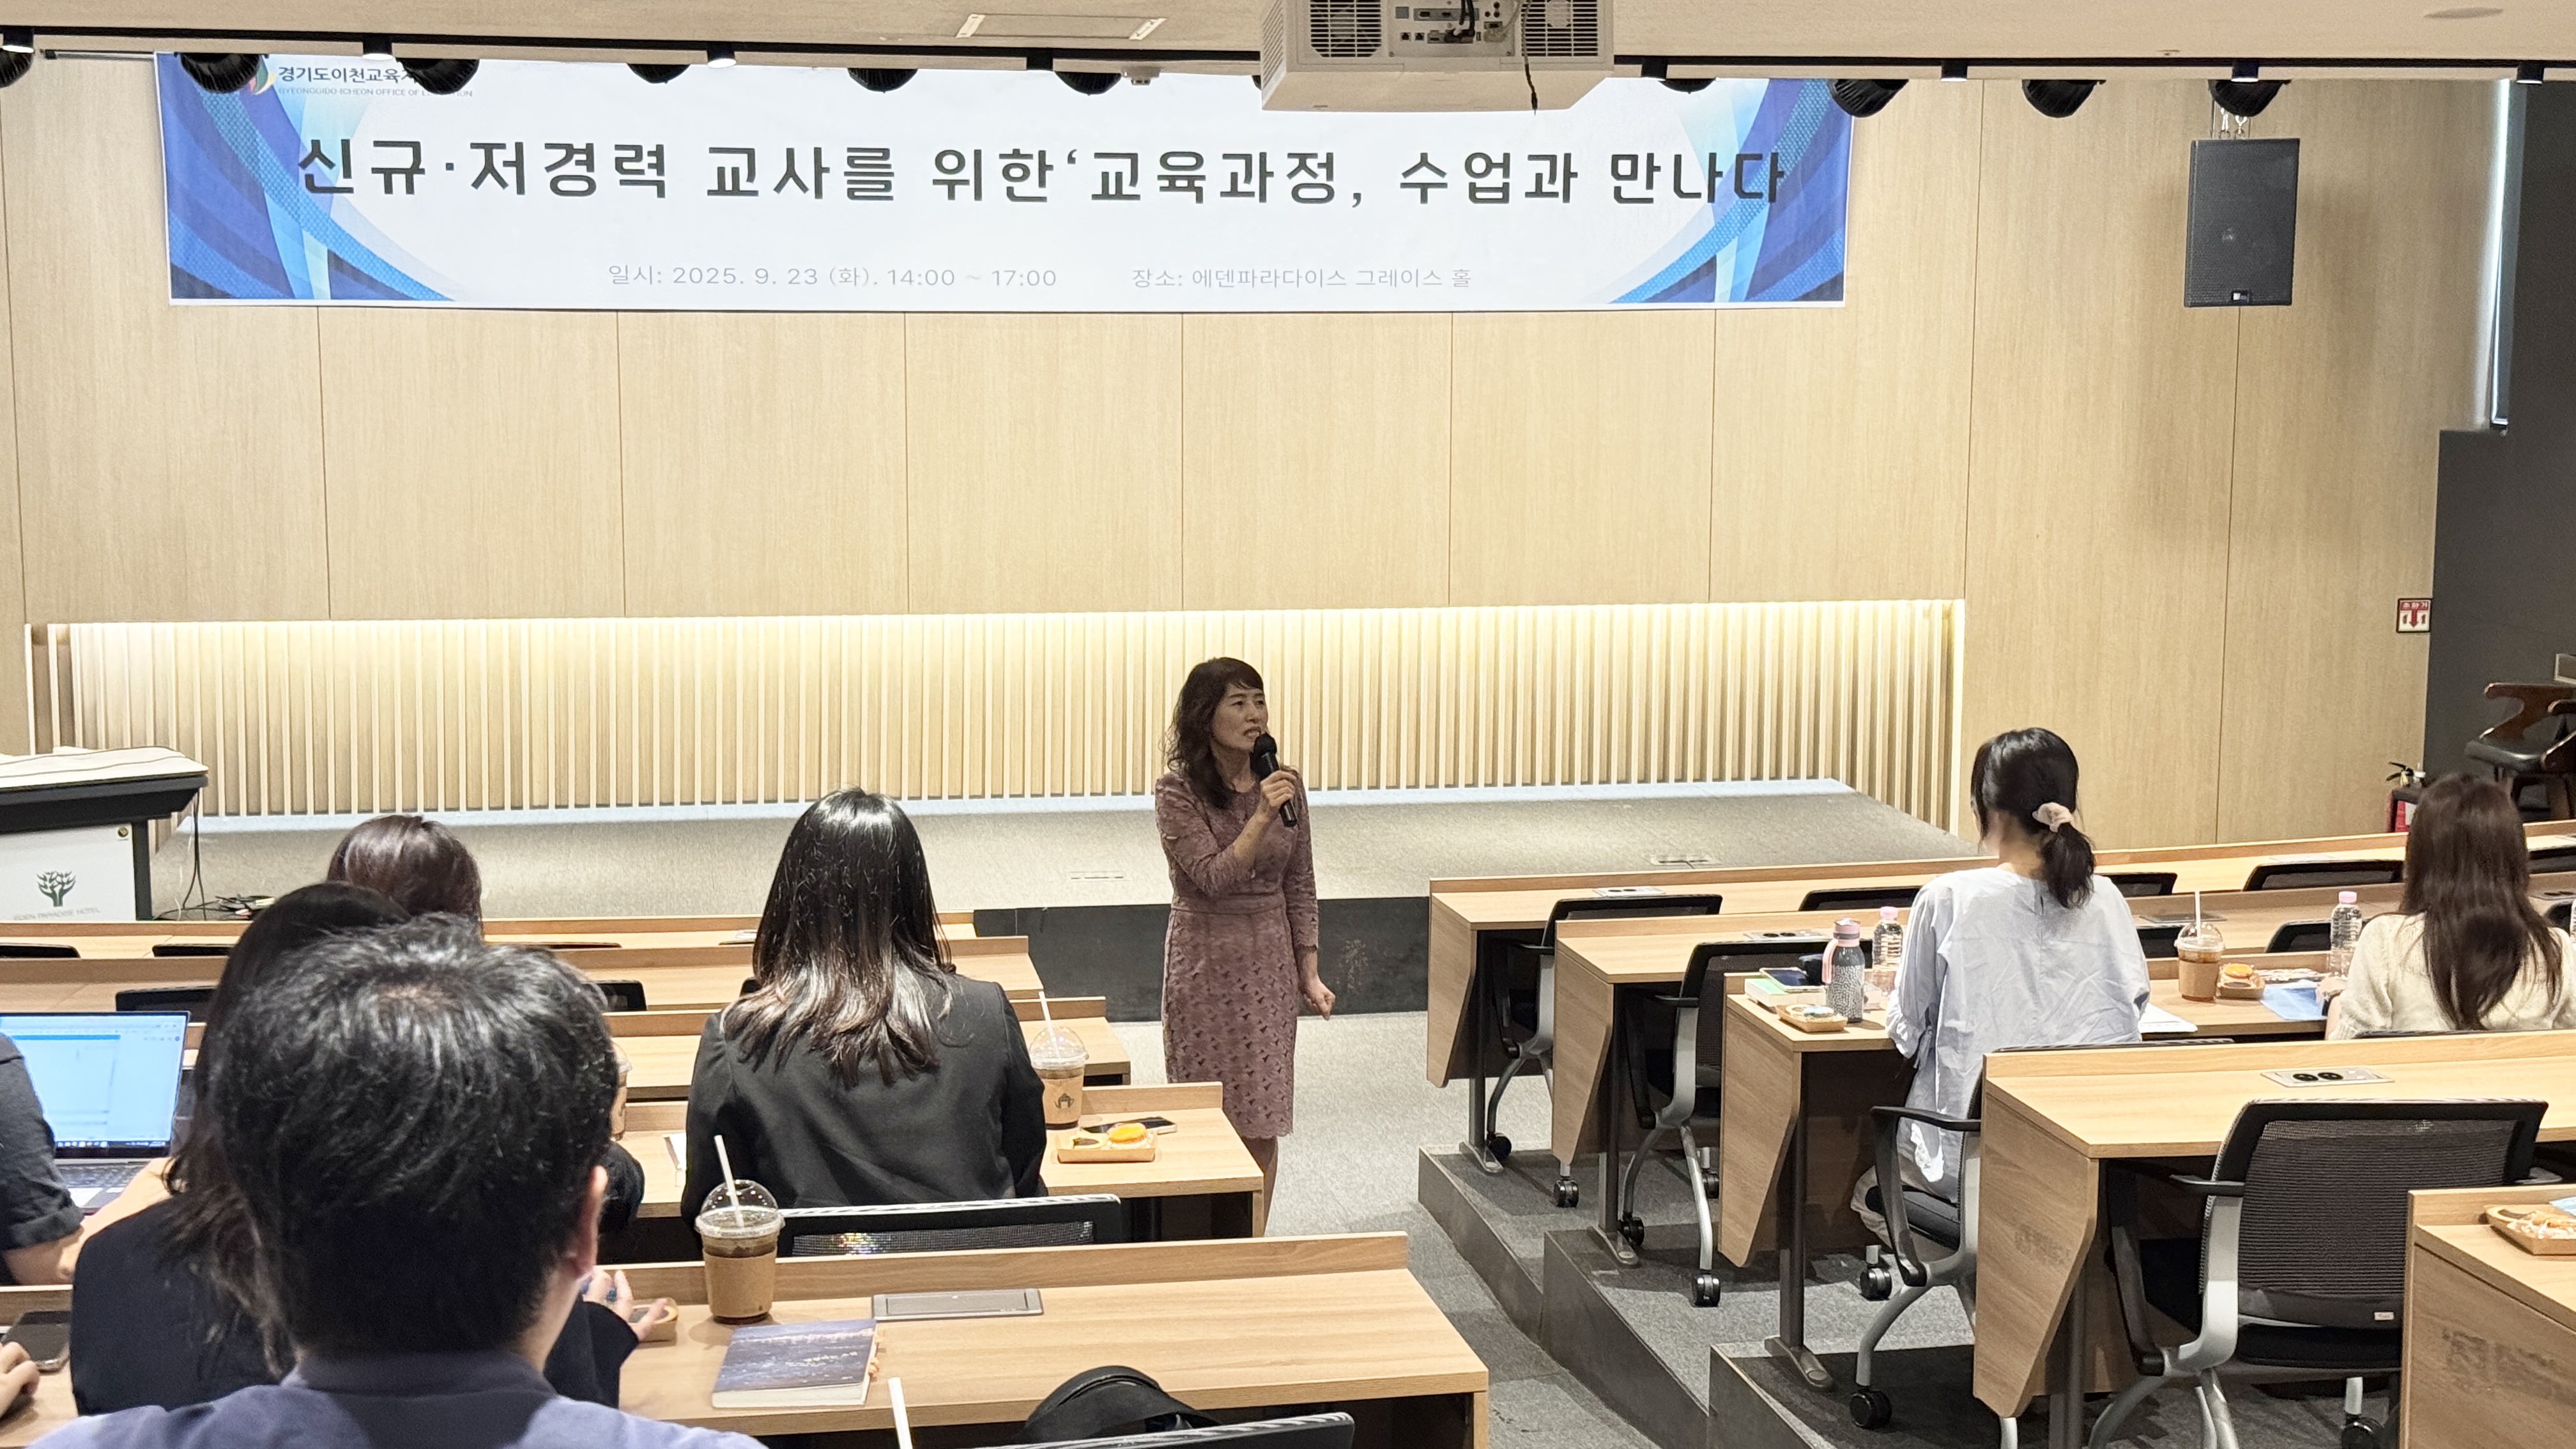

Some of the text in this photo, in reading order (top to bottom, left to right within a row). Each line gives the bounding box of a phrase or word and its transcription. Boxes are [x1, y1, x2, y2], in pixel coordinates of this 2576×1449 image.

[297, 138, 666, 199] 신규·저경력
[707, 146, 894, 201] 교사를
[1400, 152, 1578, 204] 수업과
[1610, 152, 1784, 204] 만나다
[608, 264, 662, 286] 일시:
[673, 267, 744, 284] 2025.
[755, 268, 777, 285] 9.
[787, 268, 818, 285] 23
[829, 267, 878, 287] (화).
[887, 269, 955, 286] 14:00
[992, 270, 1056, 286] 17:00
[1133, 268, 1471, 289] 장소: 에덴파라다이스 그레이스 홀
